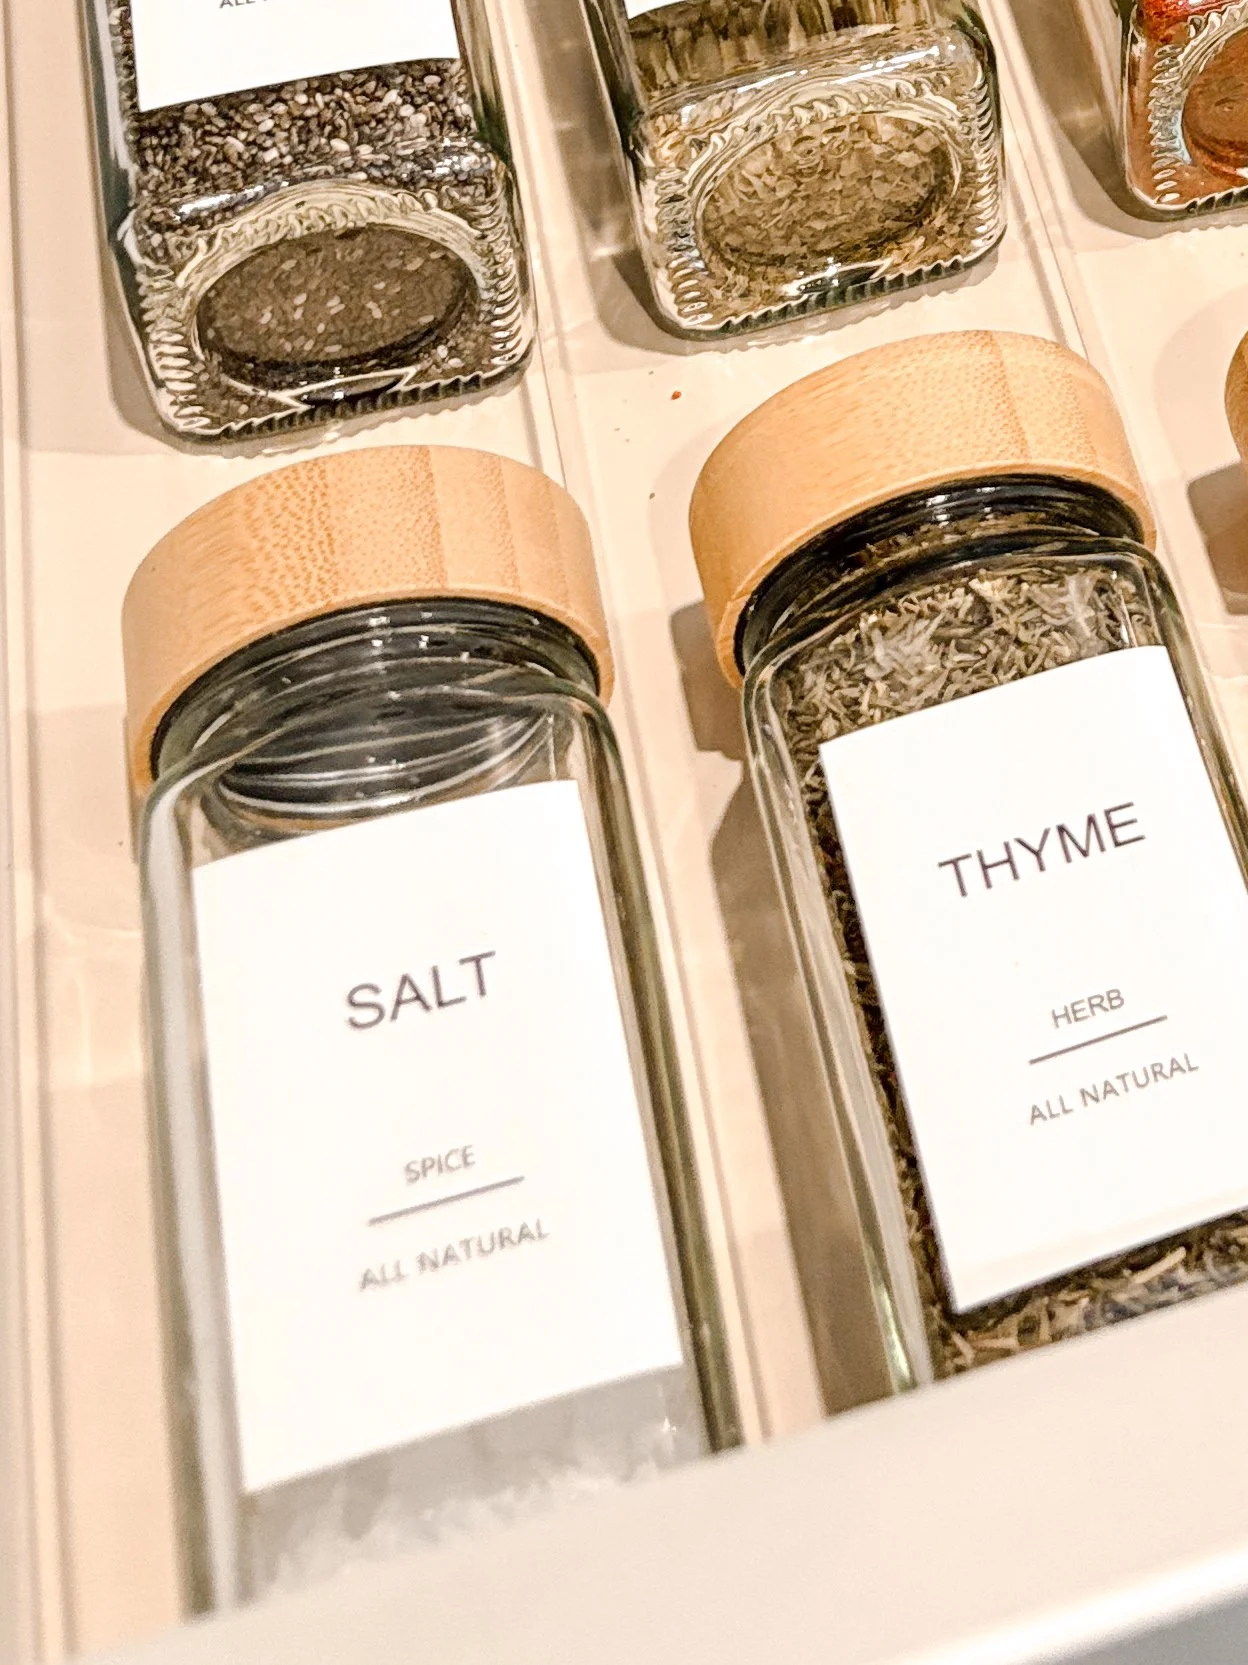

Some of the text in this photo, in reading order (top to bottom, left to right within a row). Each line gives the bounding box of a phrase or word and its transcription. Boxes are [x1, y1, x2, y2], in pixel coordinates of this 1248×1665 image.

[937, 801, 1146, 898] THYME
[346, 950, 497, 1030] SALT
[1051, 988, 1125, 1029] HERB
[1029, 1052, 1200, 1126] ALL NATURAL
[404, 1144, 476, 1184] SPICE
[359, 1218, 550, 1293] ALL NATURAL
